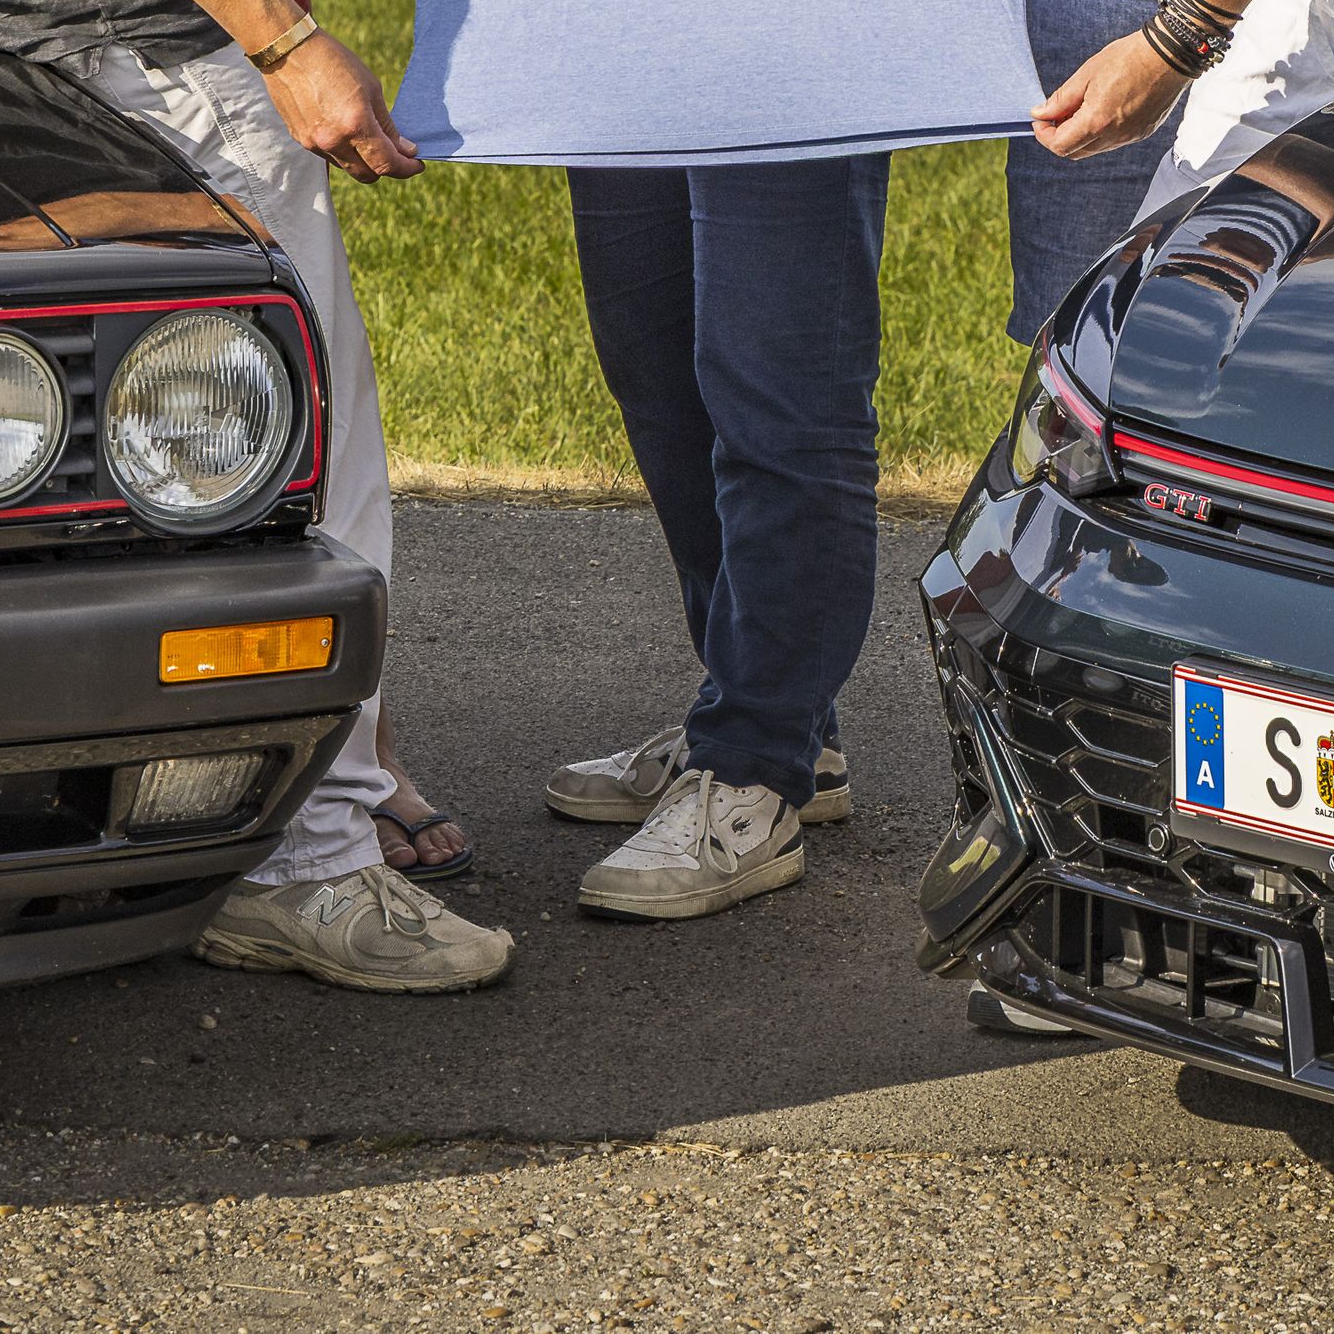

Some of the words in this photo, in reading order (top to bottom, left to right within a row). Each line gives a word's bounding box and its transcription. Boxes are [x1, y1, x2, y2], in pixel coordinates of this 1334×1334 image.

[1143, 482, 1213, 522] GTI
[1196, 759, 1215, 790] A
[1265, 717, 1302, 809] S
